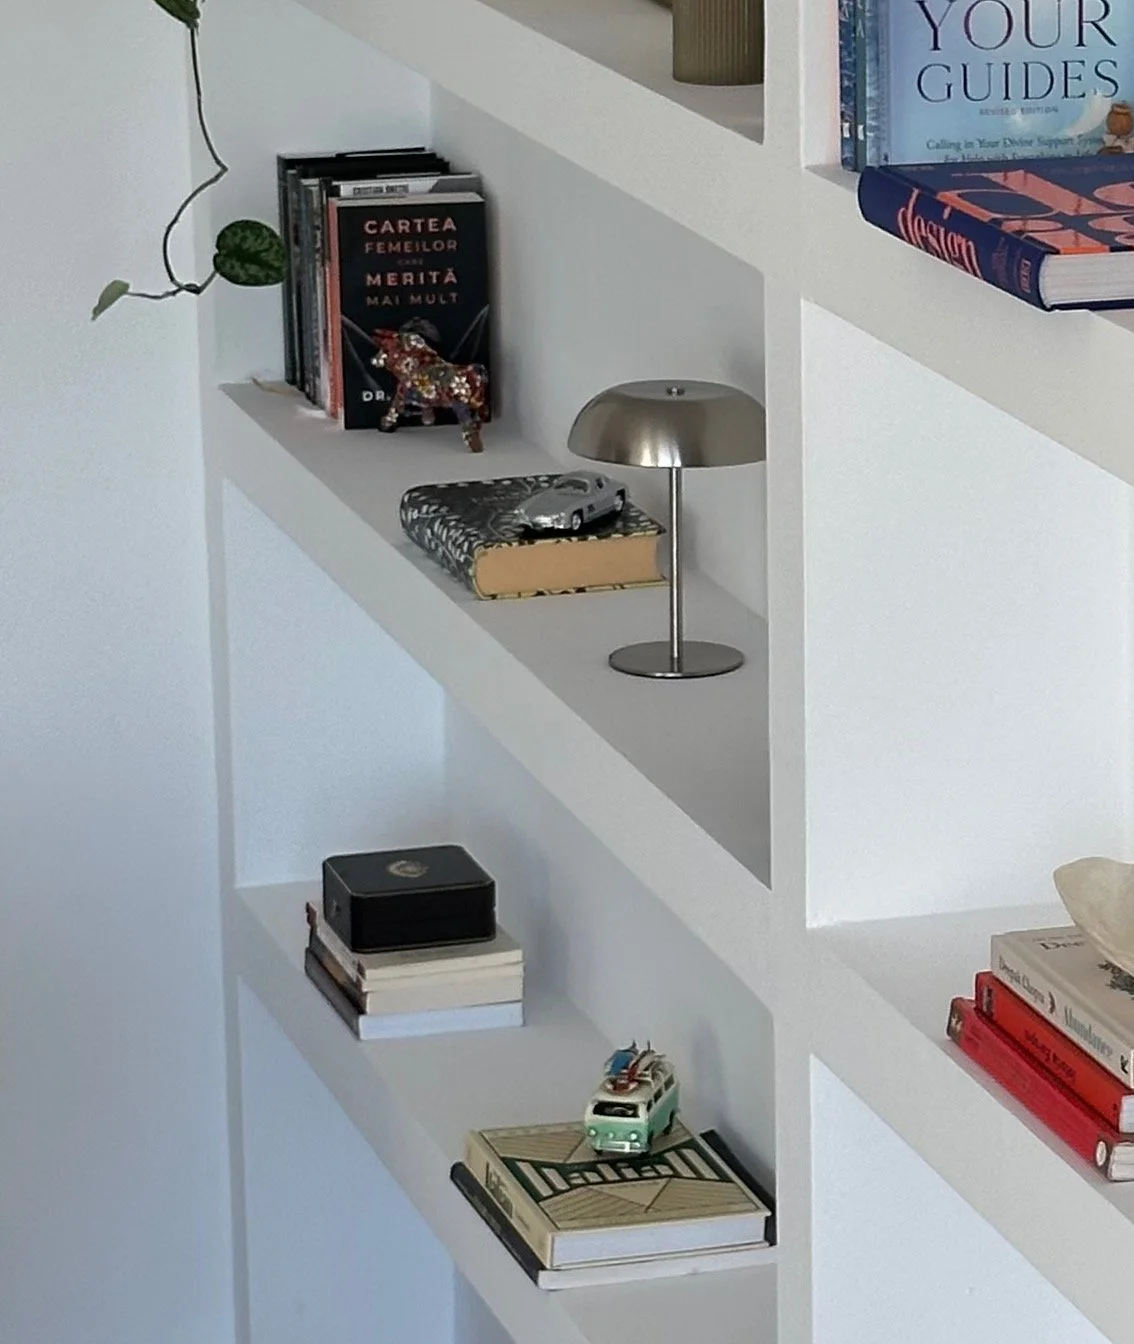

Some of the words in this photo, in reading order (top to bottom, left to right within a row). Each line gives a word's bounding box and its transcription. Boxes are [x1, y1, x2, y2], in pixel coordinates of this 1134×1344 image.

[916, 59, 1120, 103] GUIDES
[926, 139, 962, 151] Calling
[977, 138, 1000, 149] Your
[364, 217, 457, 234] CARTEA
[897, 187, 986, 279] design
[364, 240, 458, 254] FEMEILOR
[365, 268, 458, 287] MERITĂ
[366, 295, 400, 306] MAI
[410, 292, 459, 305] MULT
